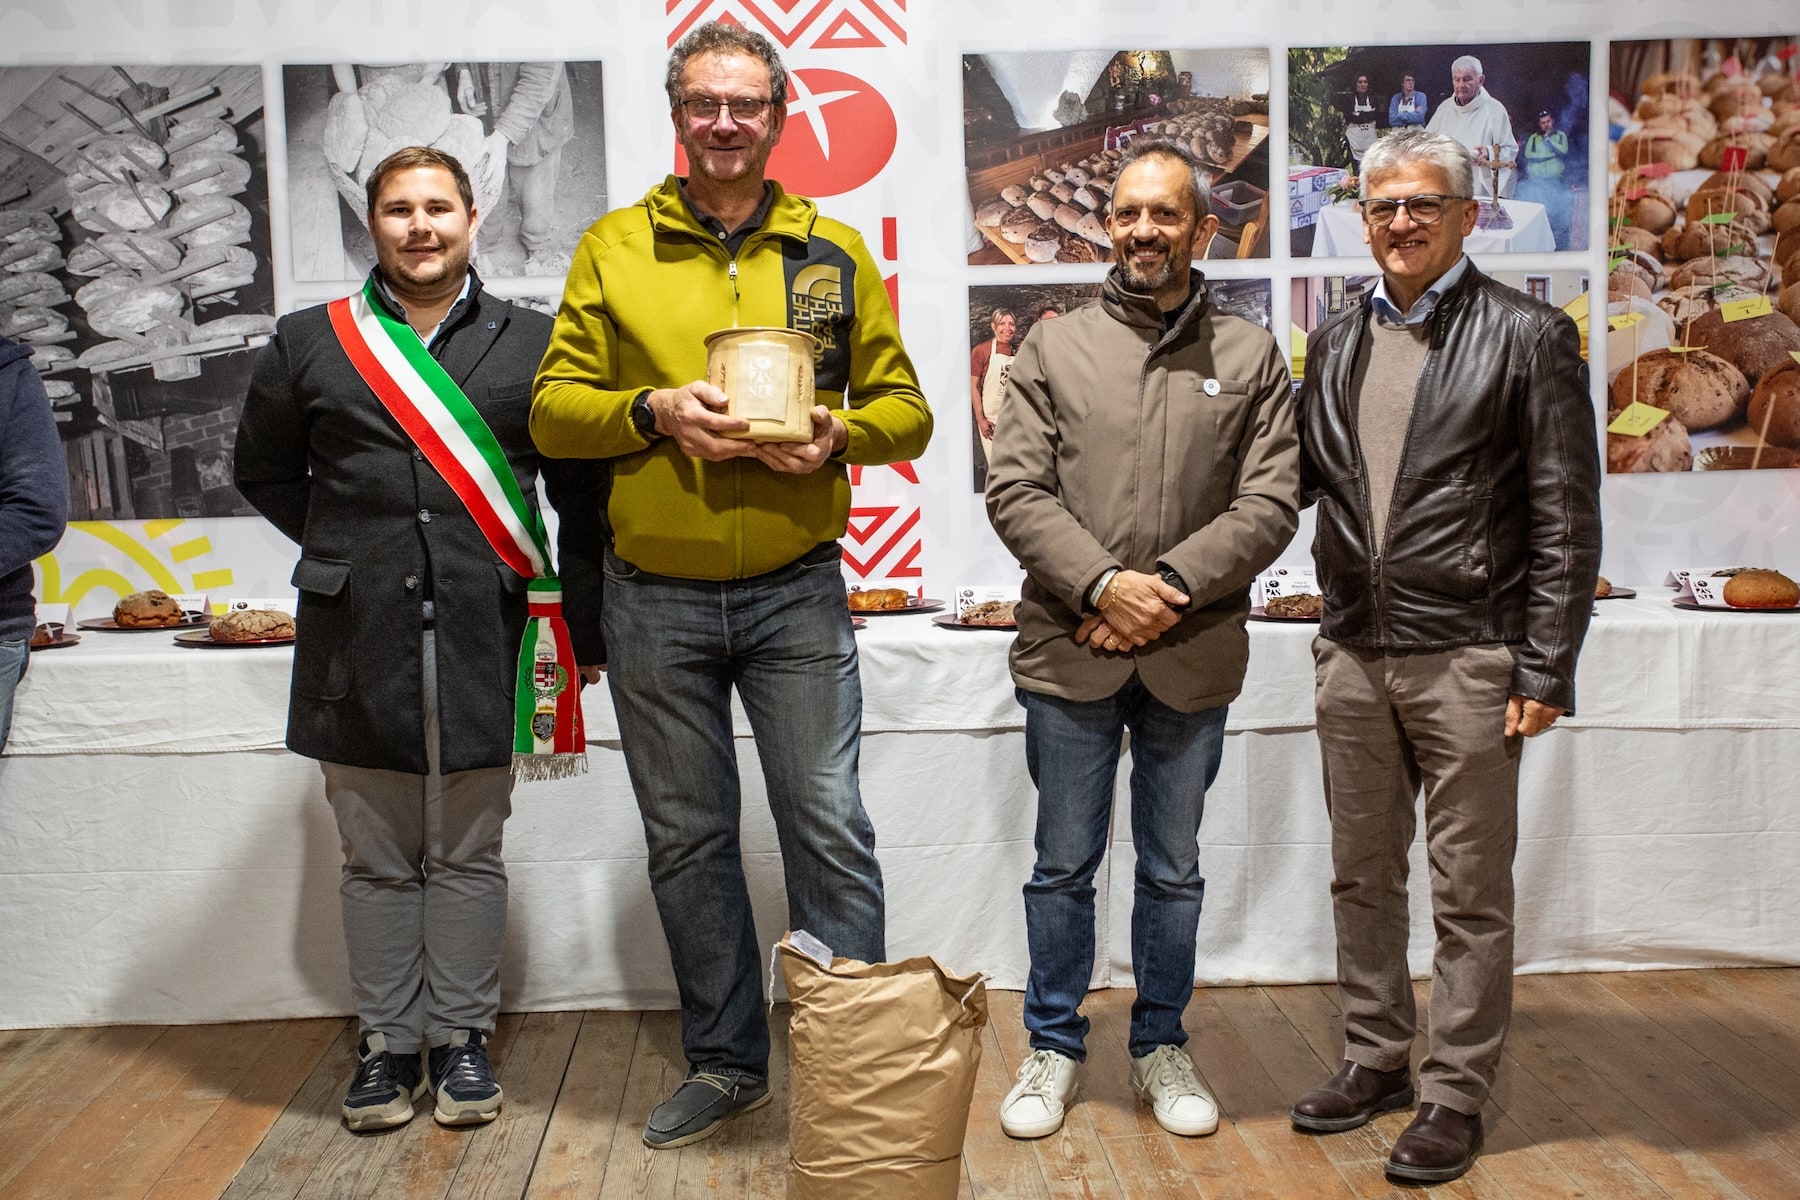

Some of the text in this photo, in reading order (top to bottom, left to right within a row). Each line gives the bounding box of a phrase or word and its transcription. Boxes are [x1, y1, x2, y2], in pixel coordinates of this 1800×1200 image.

[792, 294, 810, 332] THE
[810, 298, 828, 370] NORTH
[824, 302, 844, 350] FACE
[1266, 588, 1281, 596] PAN
